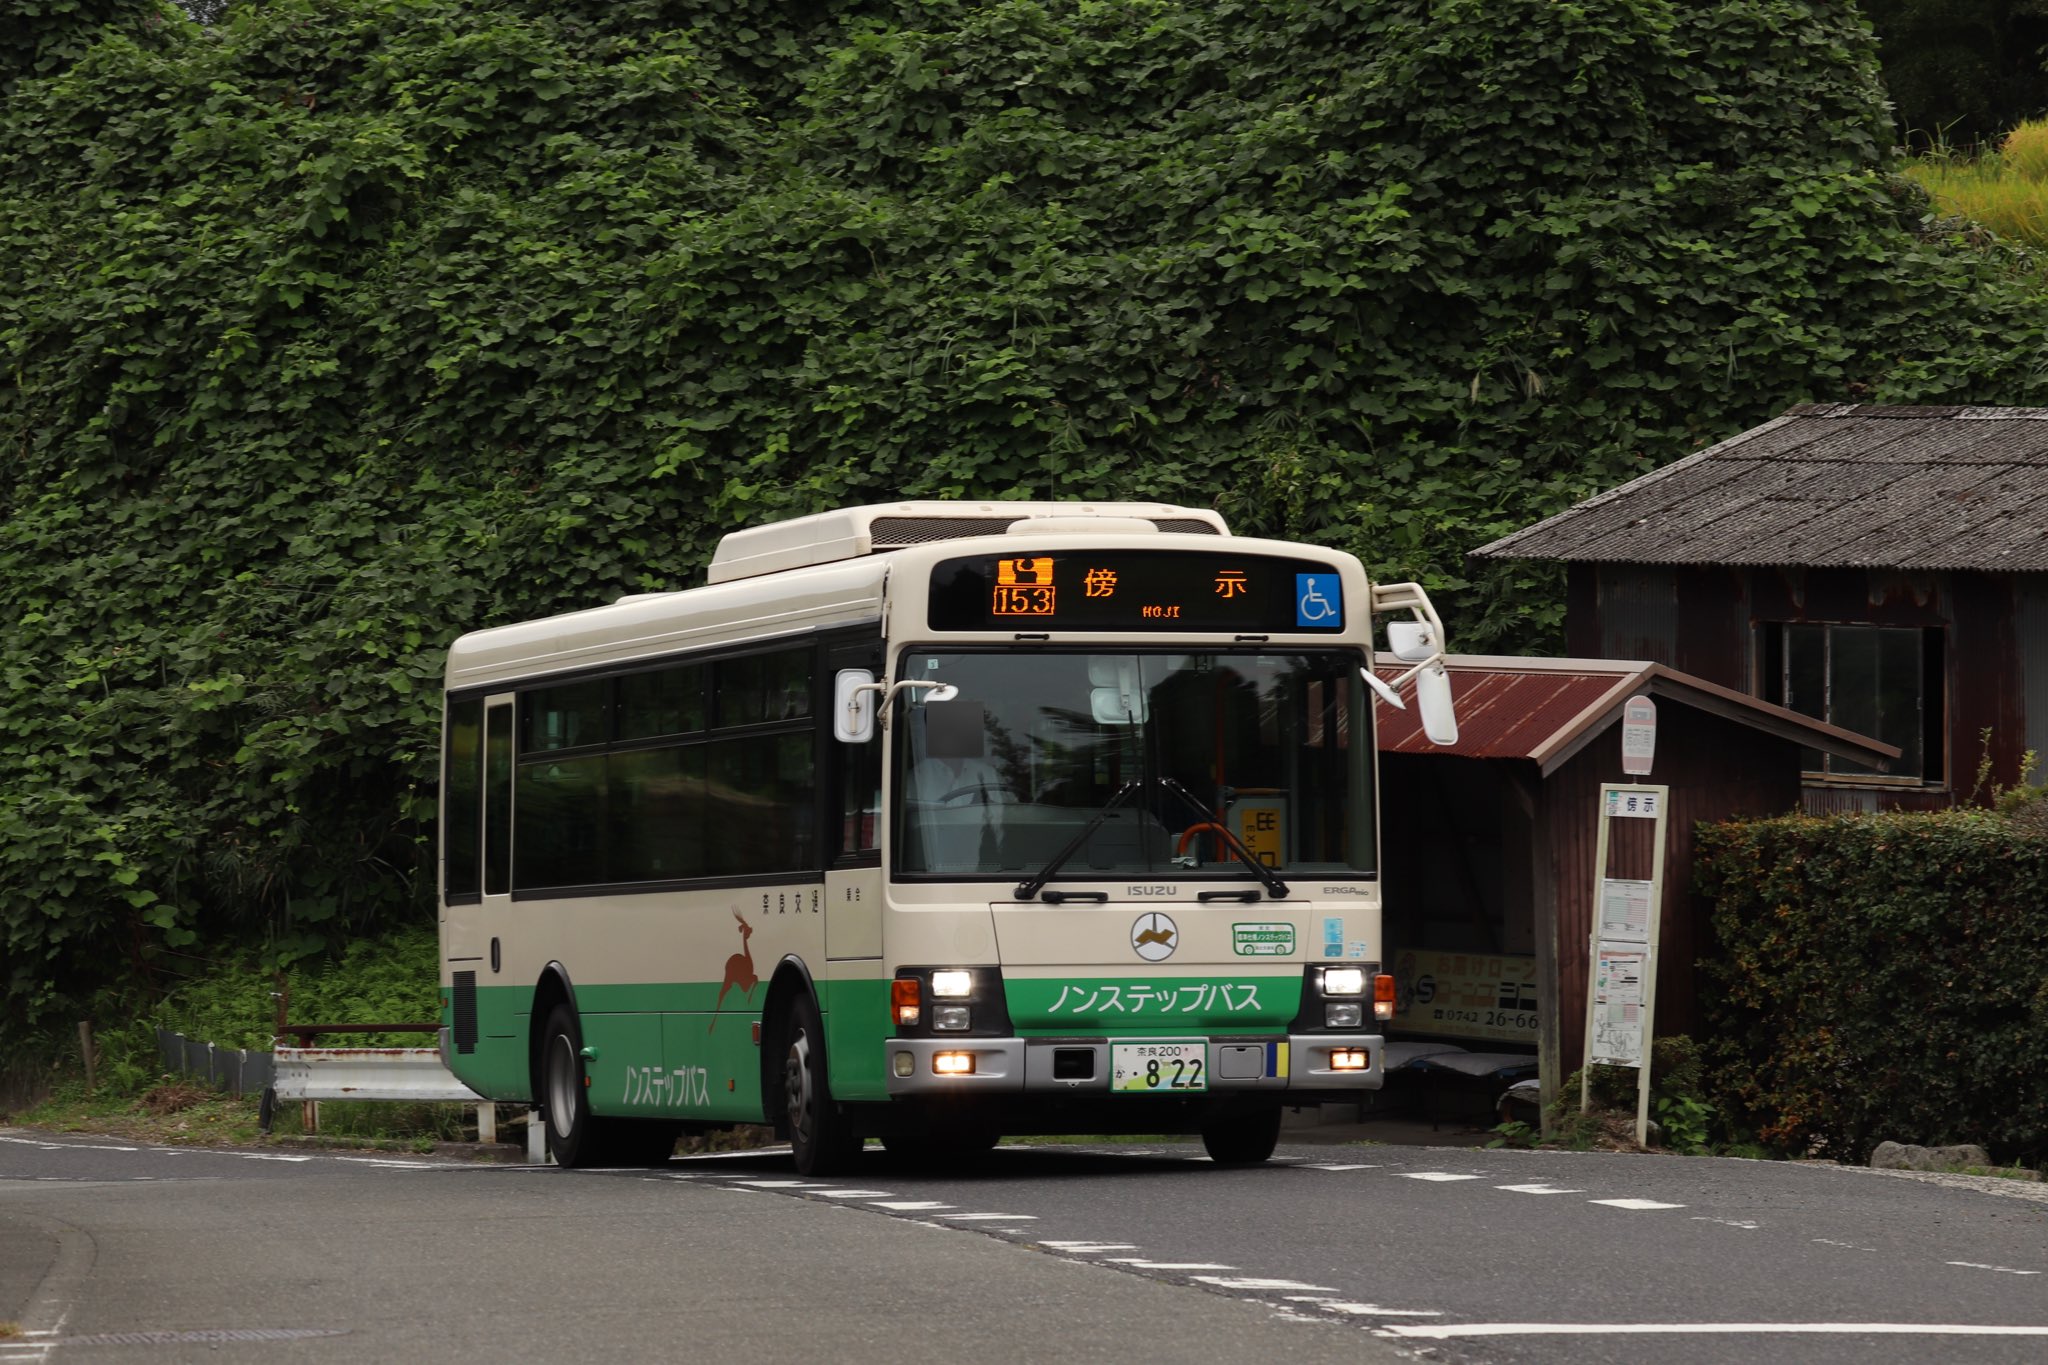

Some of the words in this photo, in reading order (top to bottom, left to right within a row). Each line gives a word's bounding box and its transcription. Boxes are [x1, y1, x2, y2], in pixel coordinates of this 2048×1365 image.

[999, 588, 1050, 613] 153
[1142, 605, 1181, 618] HOJI
[1127, 886, 1177, 896] ISUZU
[1048, 984, 1261, 1013] ノンステップバス
[623, 1065, 710, 1107] ノンステップバス
